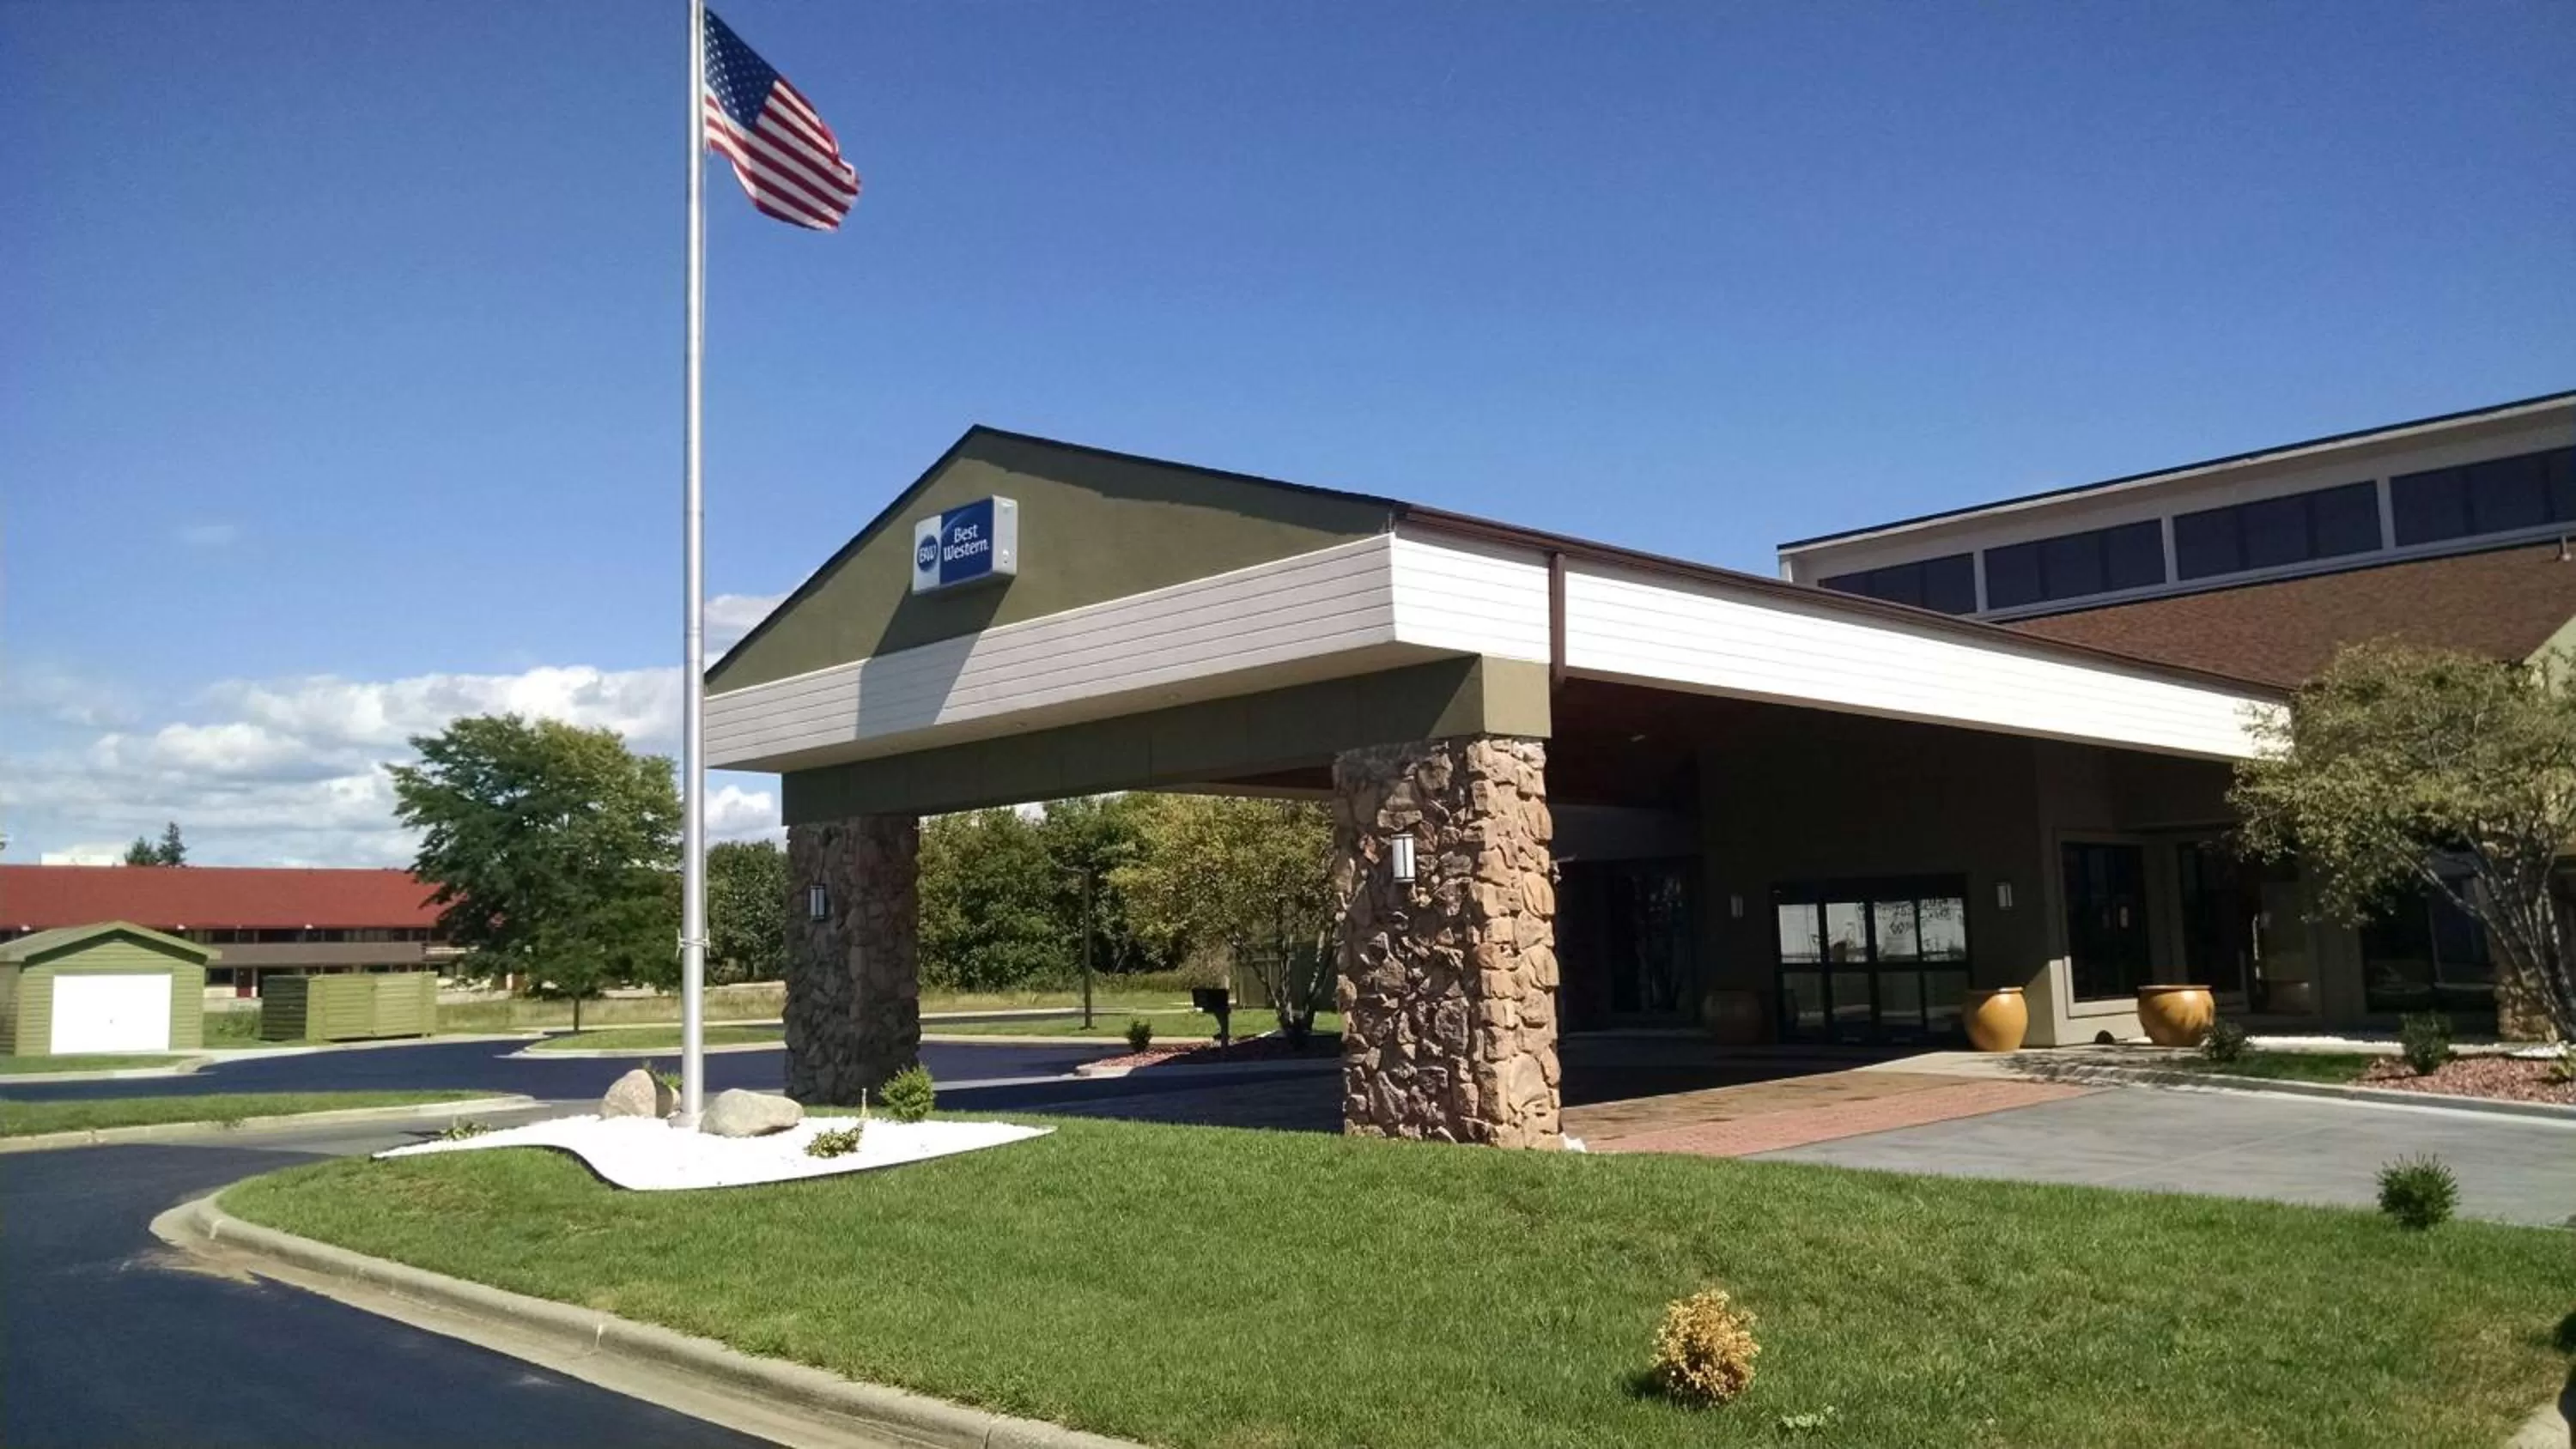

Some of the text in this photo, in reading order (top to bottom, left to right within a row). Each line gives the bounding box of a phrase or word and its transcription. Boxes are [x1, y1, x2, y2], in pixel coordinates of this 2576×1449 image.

[953, 524, 978, 543] Best
[919, 545, 937, 563] BW
[943, 539, 988, 561] Western
